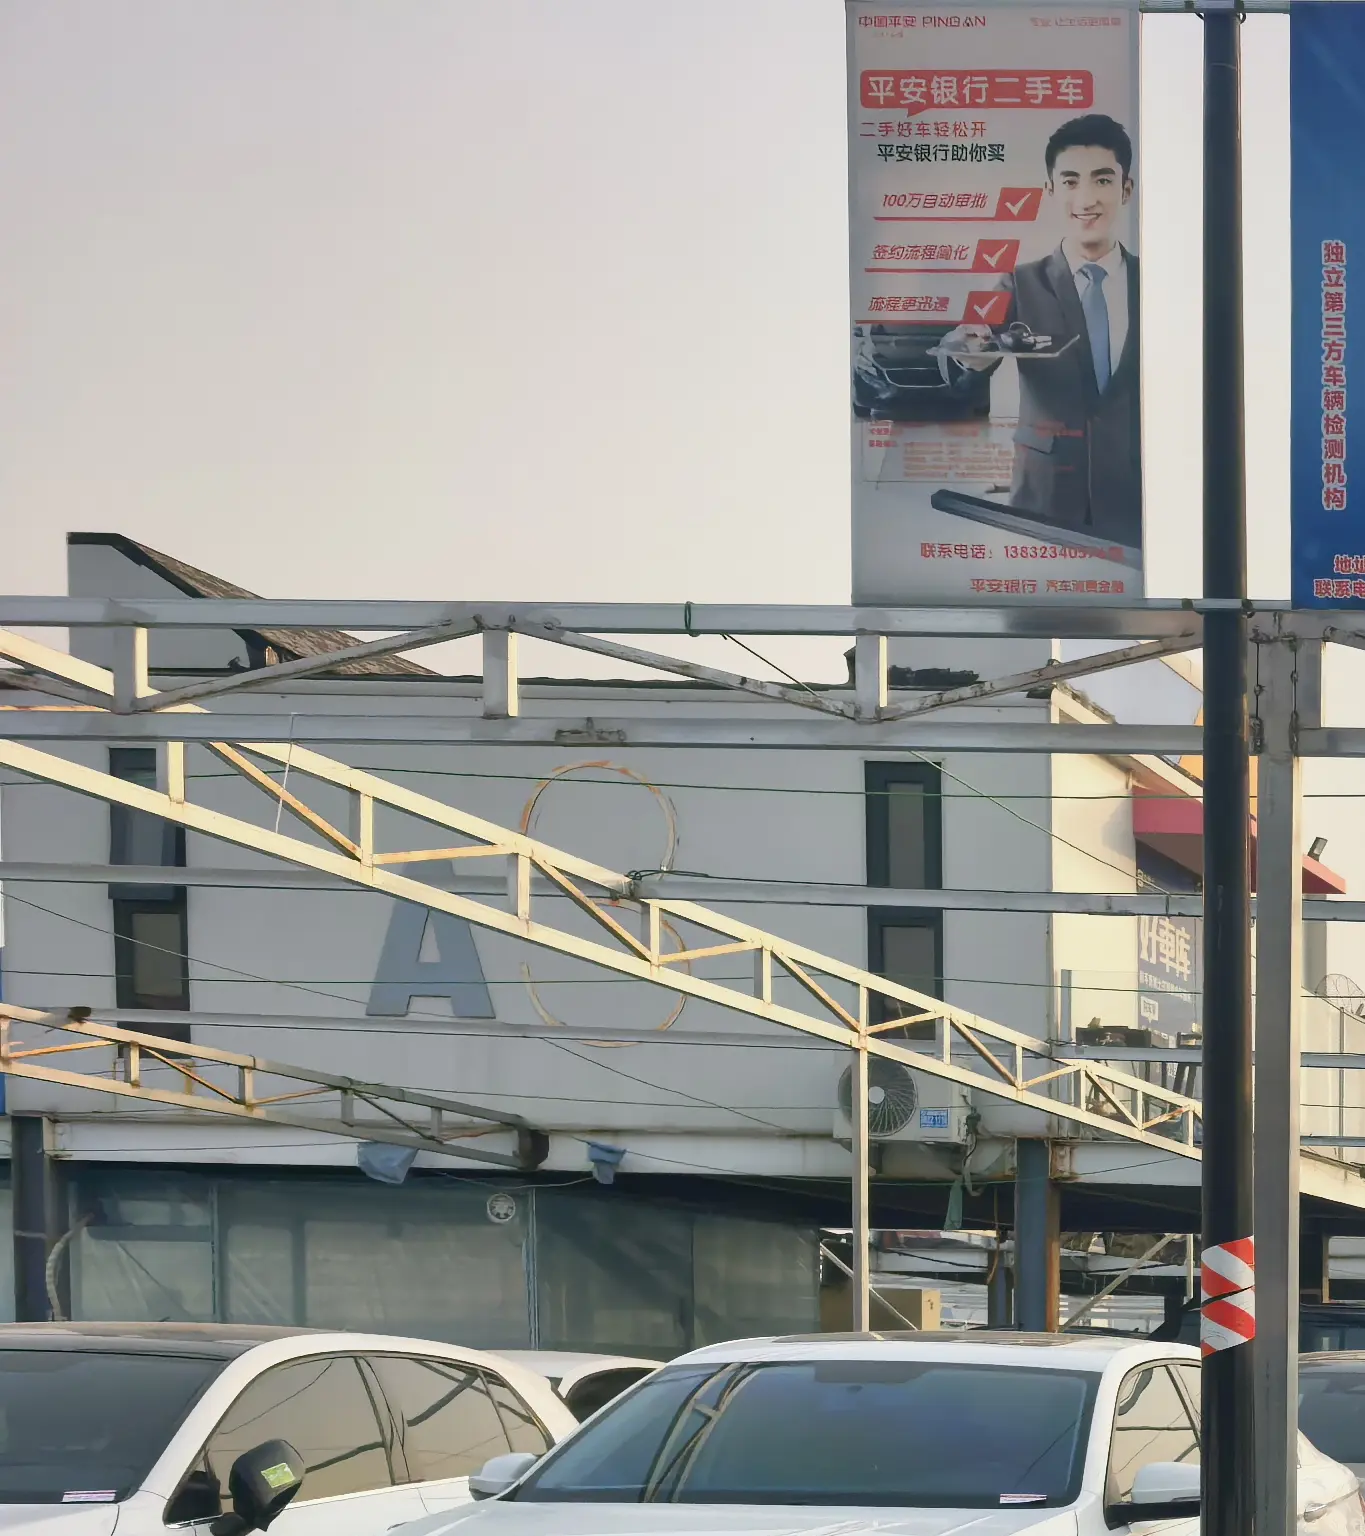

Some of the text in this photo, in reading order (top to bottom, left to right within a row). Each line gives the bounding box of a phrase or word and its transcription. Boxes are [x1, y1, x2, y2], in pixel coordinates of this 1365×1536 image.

[867, 76, 1084, 105] 平安银行二手车
[860, 121, 987, 138] 二手好车轻松开
[877, 143, 1005, 162] 平安银行助你买
[1321, 239, 1346, 510] 独立第三方车辆检测机构
[970, 578, 1037, 595] 平安银行
